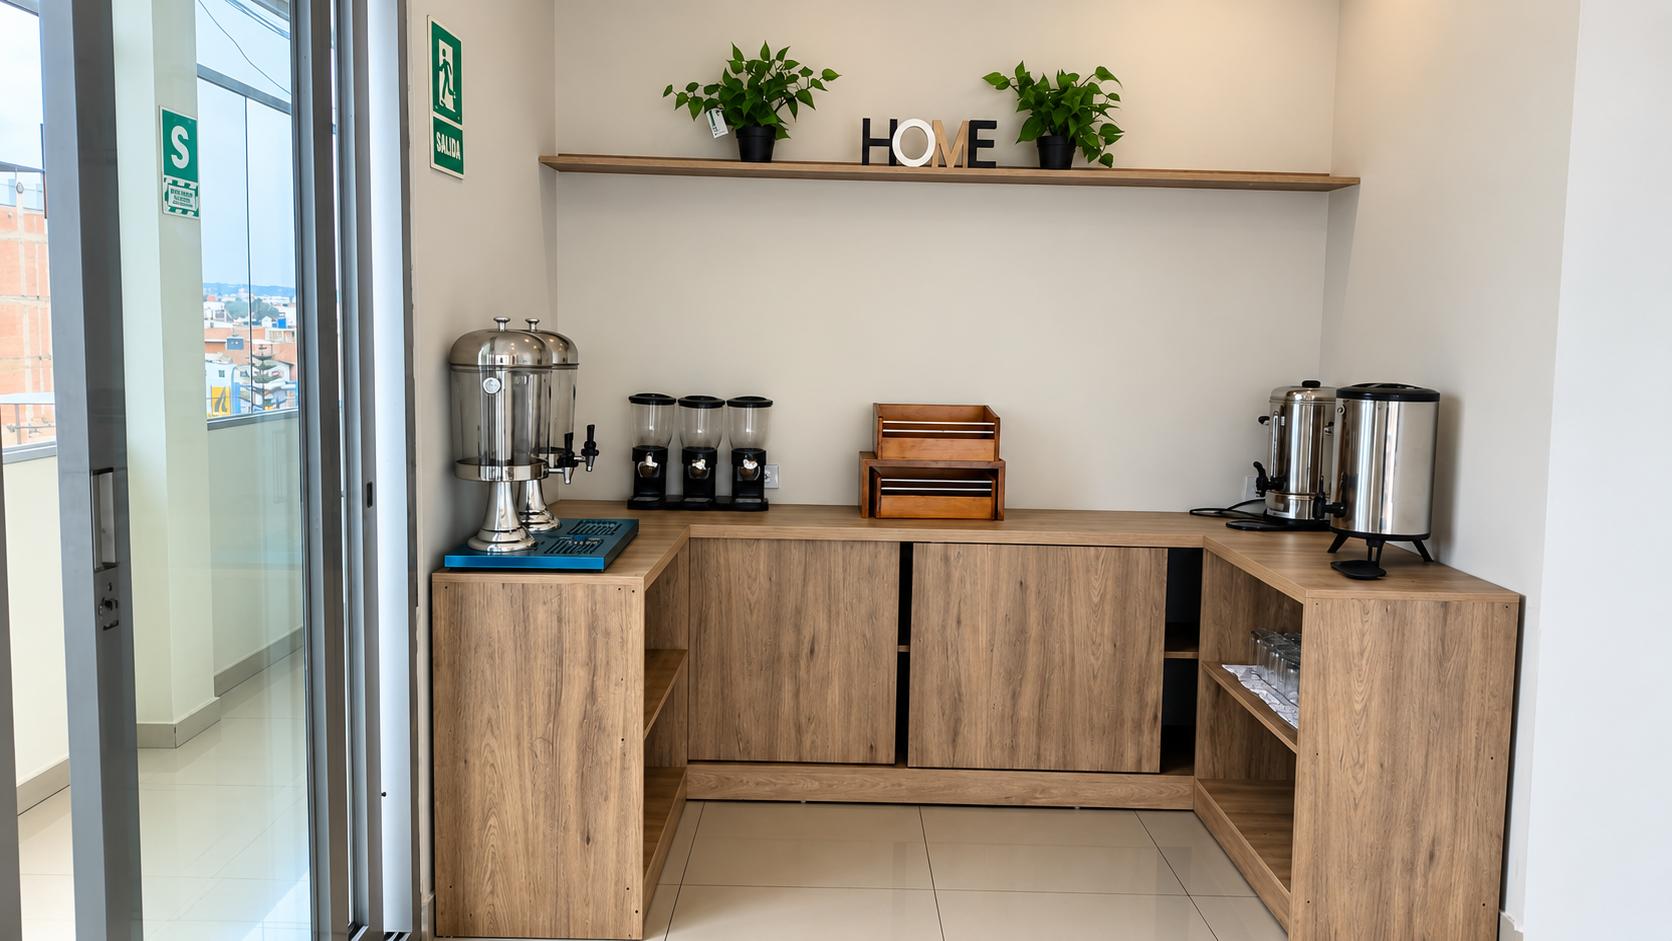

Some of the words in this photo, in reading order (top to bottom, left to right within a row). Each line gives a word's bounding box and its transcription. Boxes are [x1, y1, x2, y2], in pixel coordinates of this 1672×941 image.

[171, 125, 190, 169] S
[436, 131, 461, 160] SALIDA
[862, 118, 997, 168] HOME
